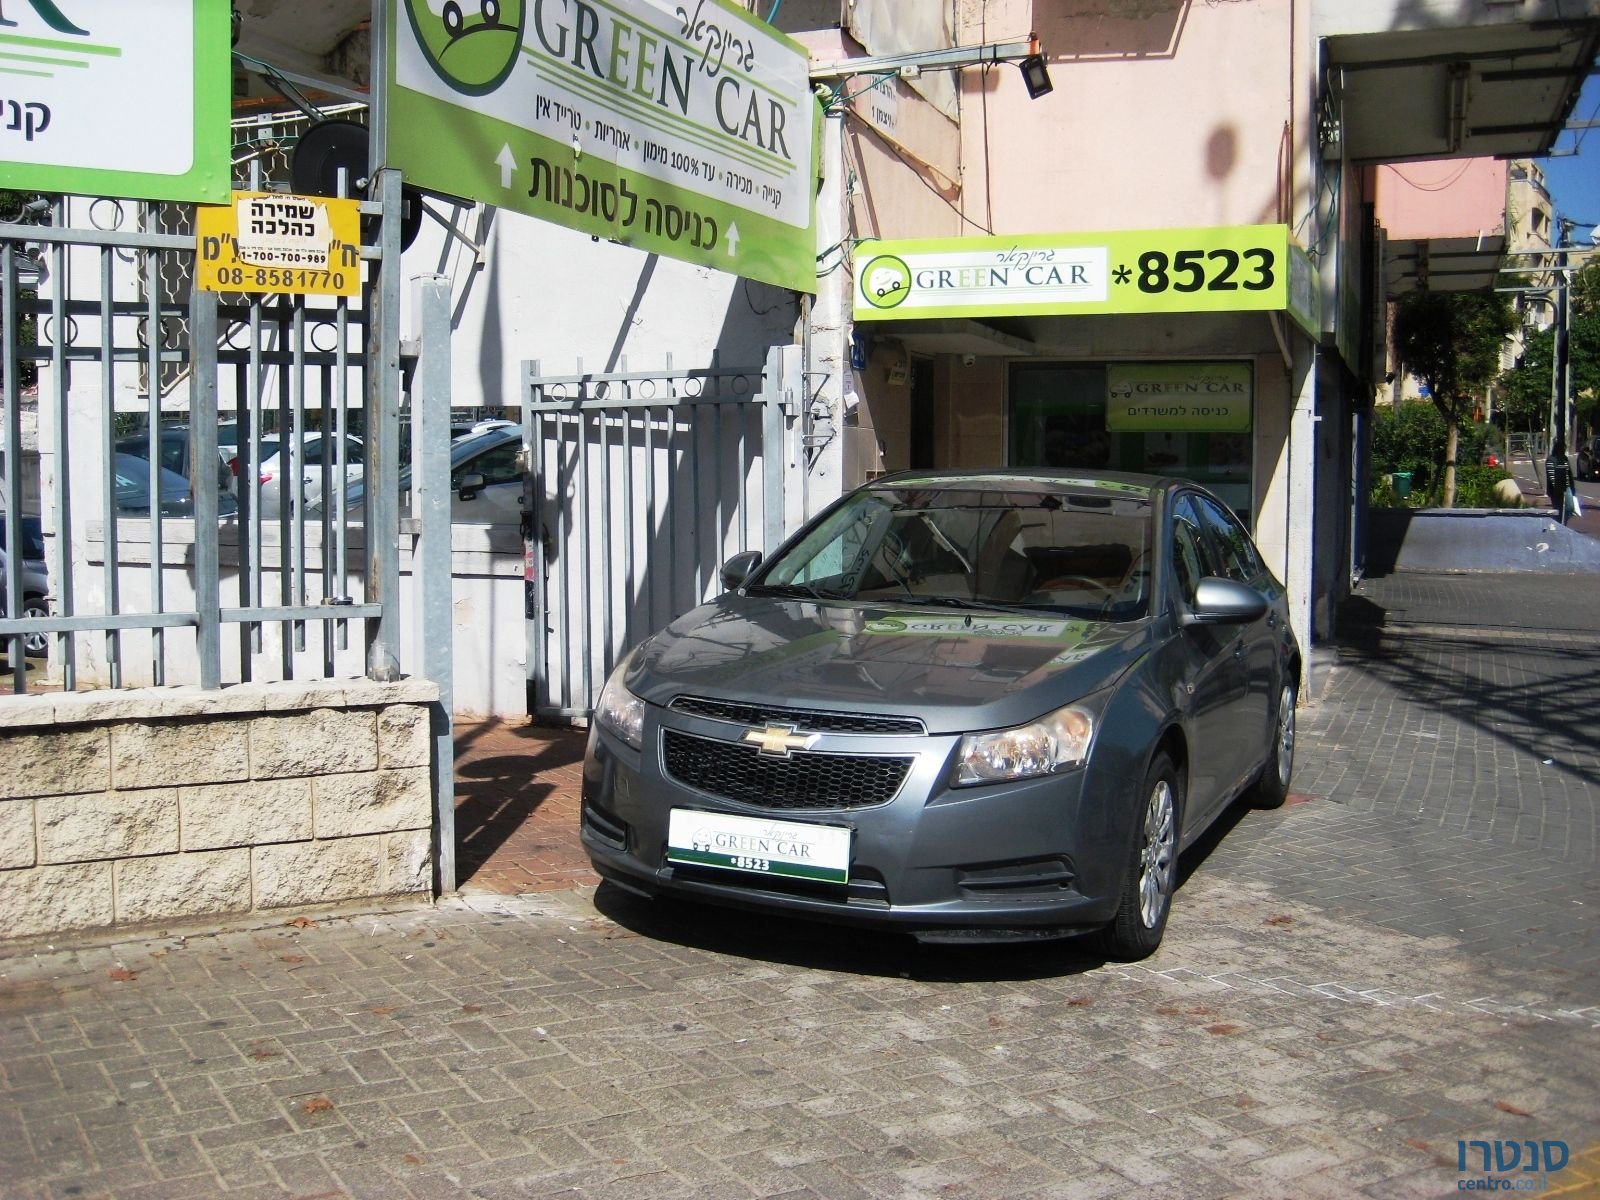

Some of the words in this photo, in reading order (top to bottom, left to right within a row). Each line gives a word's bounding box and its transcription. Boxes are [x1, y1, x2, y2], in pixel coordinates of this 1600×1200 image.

[534, 0, 696, 116] GREEN
[715, 76, 792, 160] CAR
[536, 94, 551, 120] אין
[553, 101, 582, 130] טרייד
[594, 120, 630, 152] אחריות
[643, 140, 668, 165] מימון
[671, 152, 700, 176] 100%
[702, 161, 715, 182] עד
[726, 171, 753, 196] מכירה
[528, 157, 638, 227] לסוכנות
[762, 184, 783, 209] קנייה
[251, 202, 315, 220] שמירה
[251, 219, 315, 237] כהלכה
[644, 198, 718, 251] כניסה
[240, 250, 327, 264] 1-700-700-989
[217, 266, 345, 290] 08-8581770
[916, 267, 1009, 290] GREEN
[1025, 264, 1091, 286] CAR
[1136, 382, 1198, 393] GREEN
[1206, 382, 1244, 393] CAR
[1127, 405, 1187, 416] למשרדים
[1192, 407, 1229, 416] כניסה
[715, 833, 770, 852] GREEN
[777, 841, 811, 858] CAR
